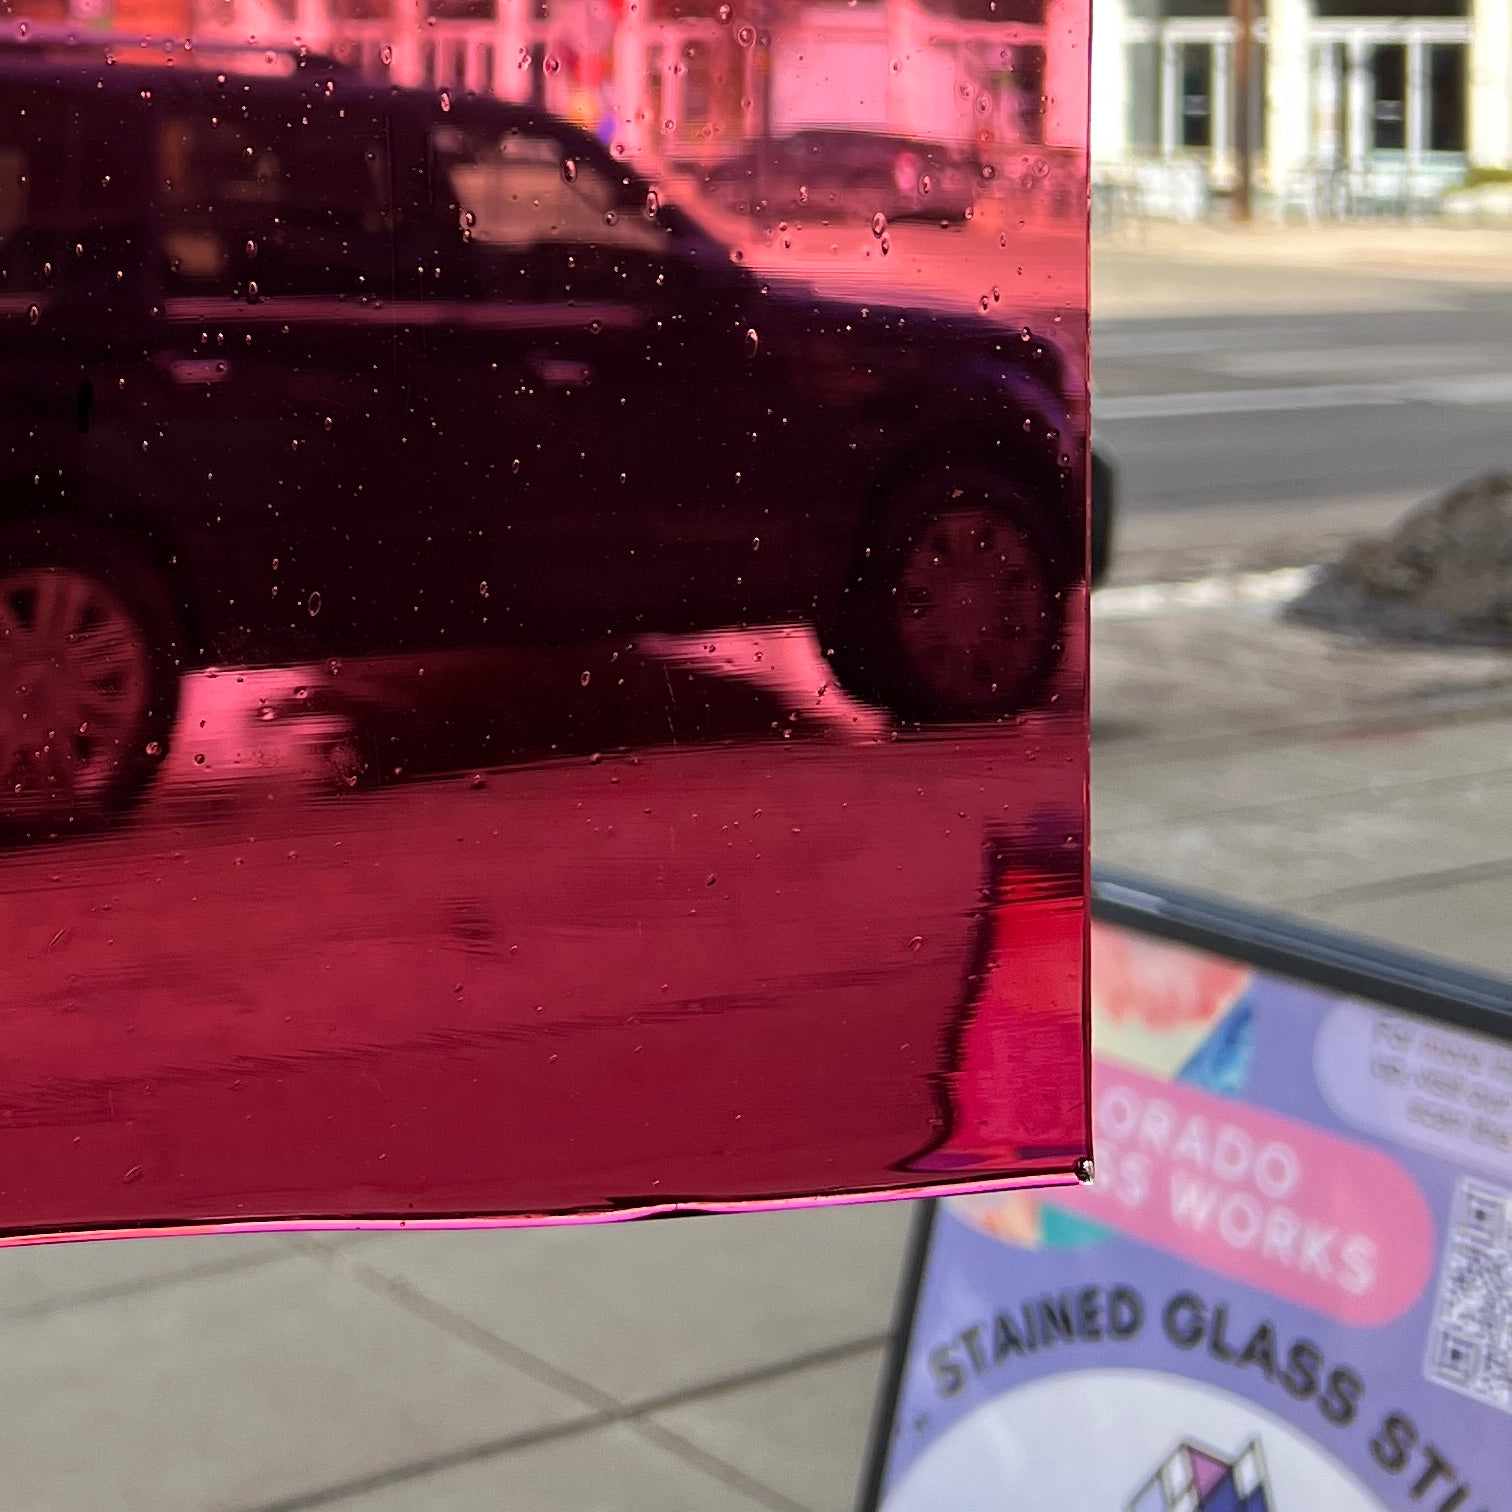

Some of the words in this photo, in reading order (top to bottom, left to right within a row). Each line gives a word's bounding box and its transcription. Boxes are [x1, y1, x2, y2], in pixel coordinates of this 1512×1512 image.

[1096, 1085, 1300, 1198] ORADO
[1168, 1170, 1378, 1296] WORKS
[929, 1283, 1146, 1400] STAINED
[1161, 1291, 1367, 1428] GLASS
